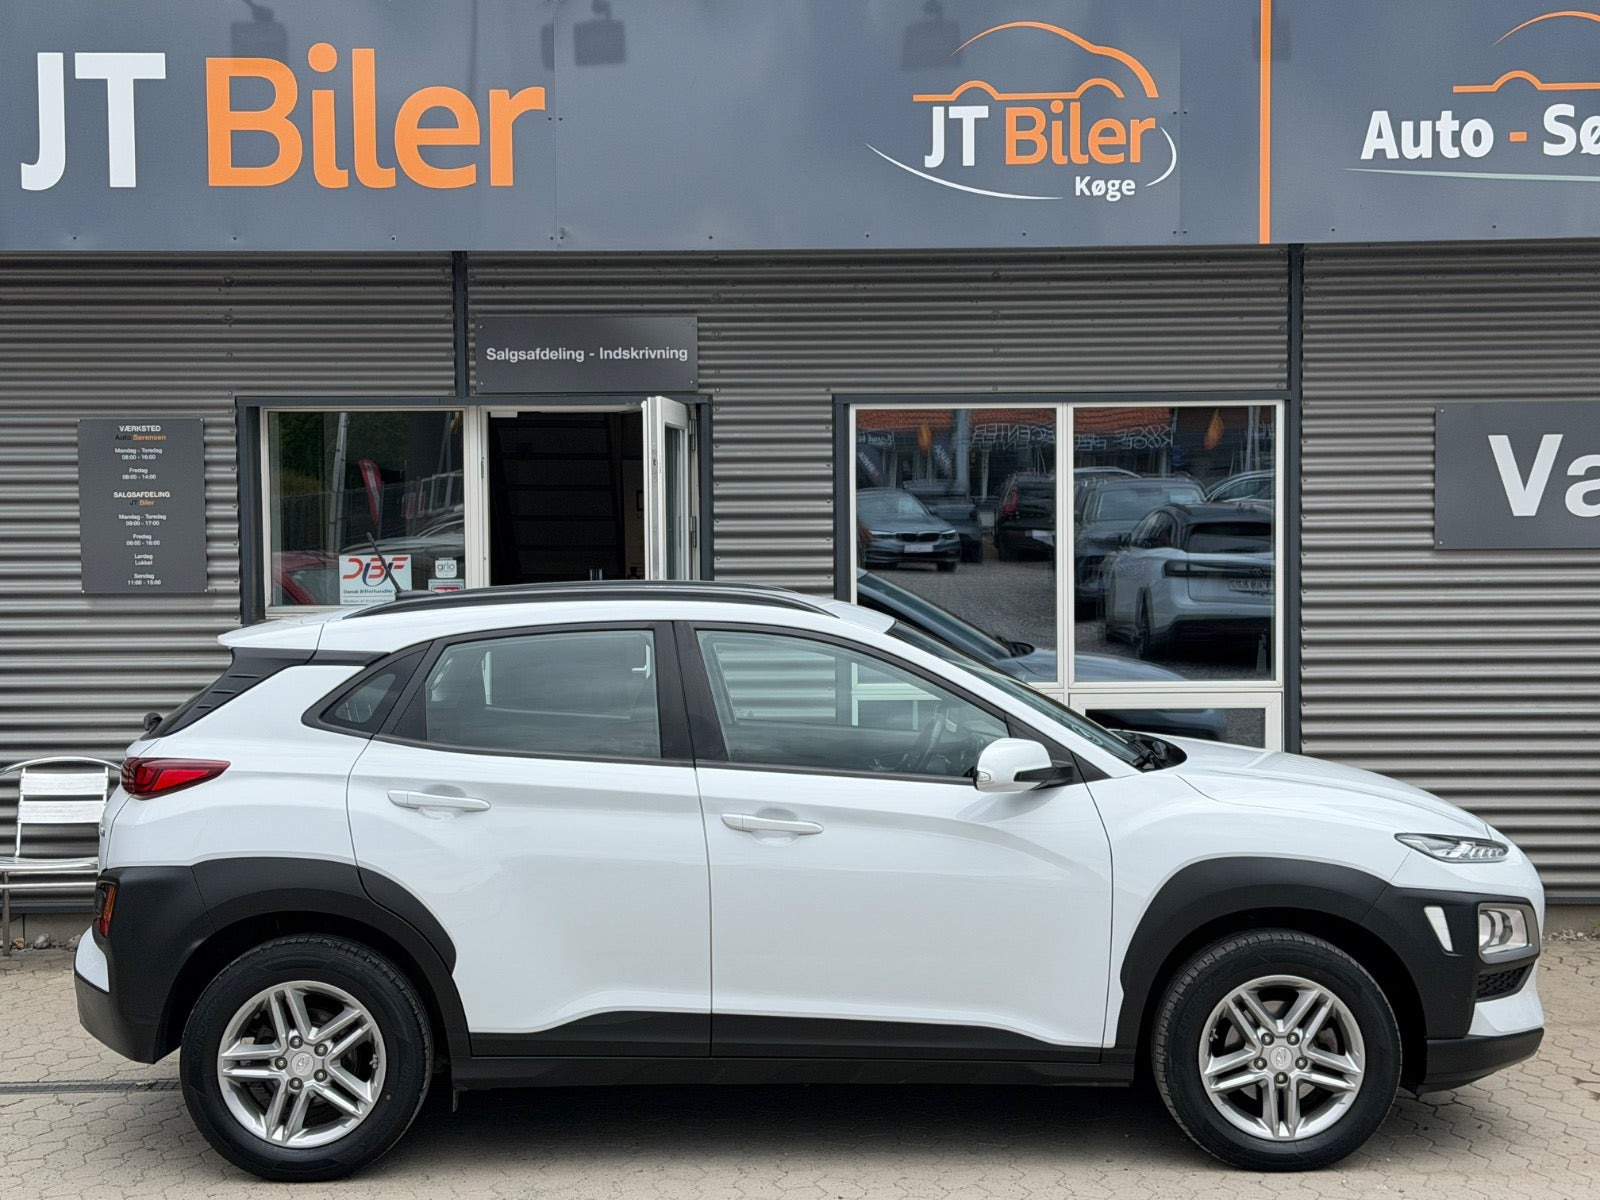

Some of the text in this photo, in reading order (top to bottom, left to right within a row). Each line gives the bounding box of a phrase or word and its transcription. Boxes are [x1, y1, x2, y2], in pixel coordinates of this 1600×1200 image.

[21, 42, 545, 190] JT Biler
[924, 100, 1155, 168] JT Biler
[1360, 110, 1494, 160] Auto
[1509, 131, 1528, 142] -
[1075, 176, 1136, 201] Køge
[486, 347, 585, 363] Salgsafdeling
[599, 347, 688, 361] Indskrivning
